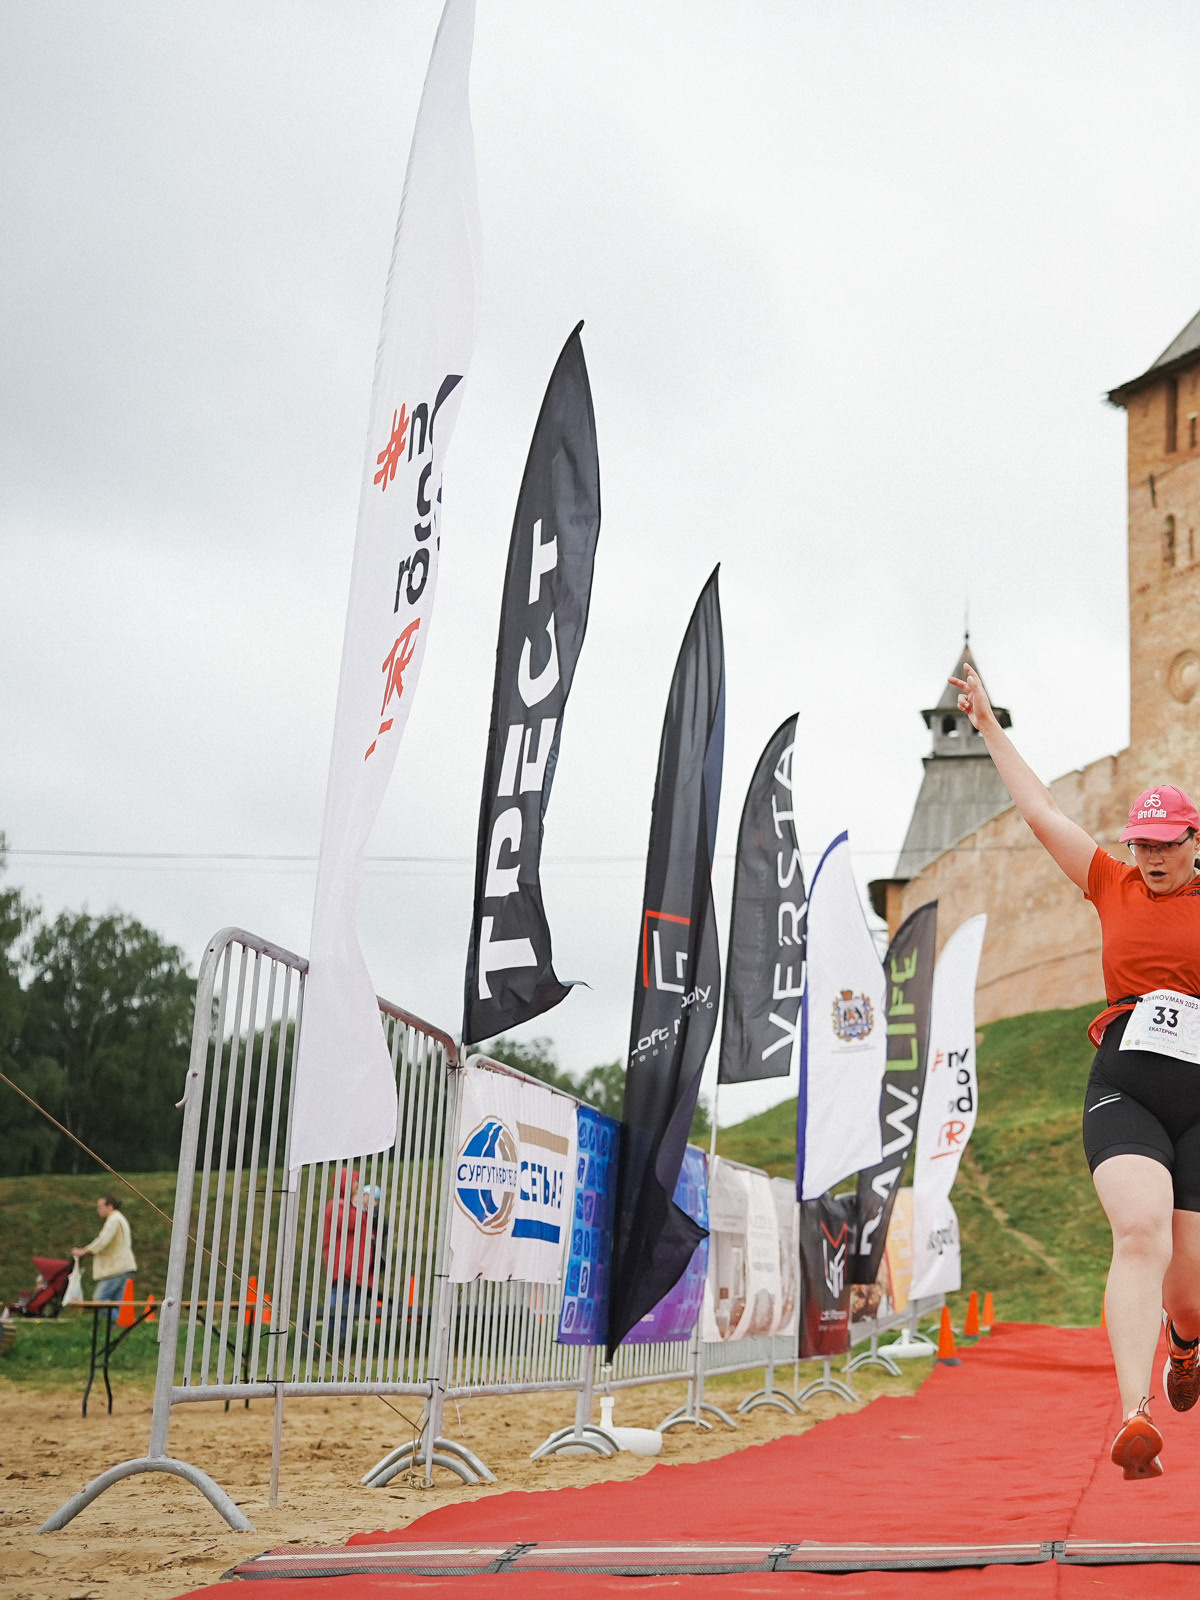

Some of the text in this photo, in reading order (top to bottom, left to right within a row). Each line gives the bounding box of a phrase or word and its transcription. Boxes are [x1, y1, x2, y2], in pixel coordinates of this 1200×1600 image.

[761, 742, 808, 1061] VERSTA
[885, 947, 919, 1072] LIFE
[1184, 1000, 1199, 1010] 2023
[1152, 1006, 1179, 1028] 33
[1148, 1026, 1178, 1037] ЕКАТЕРИНА
